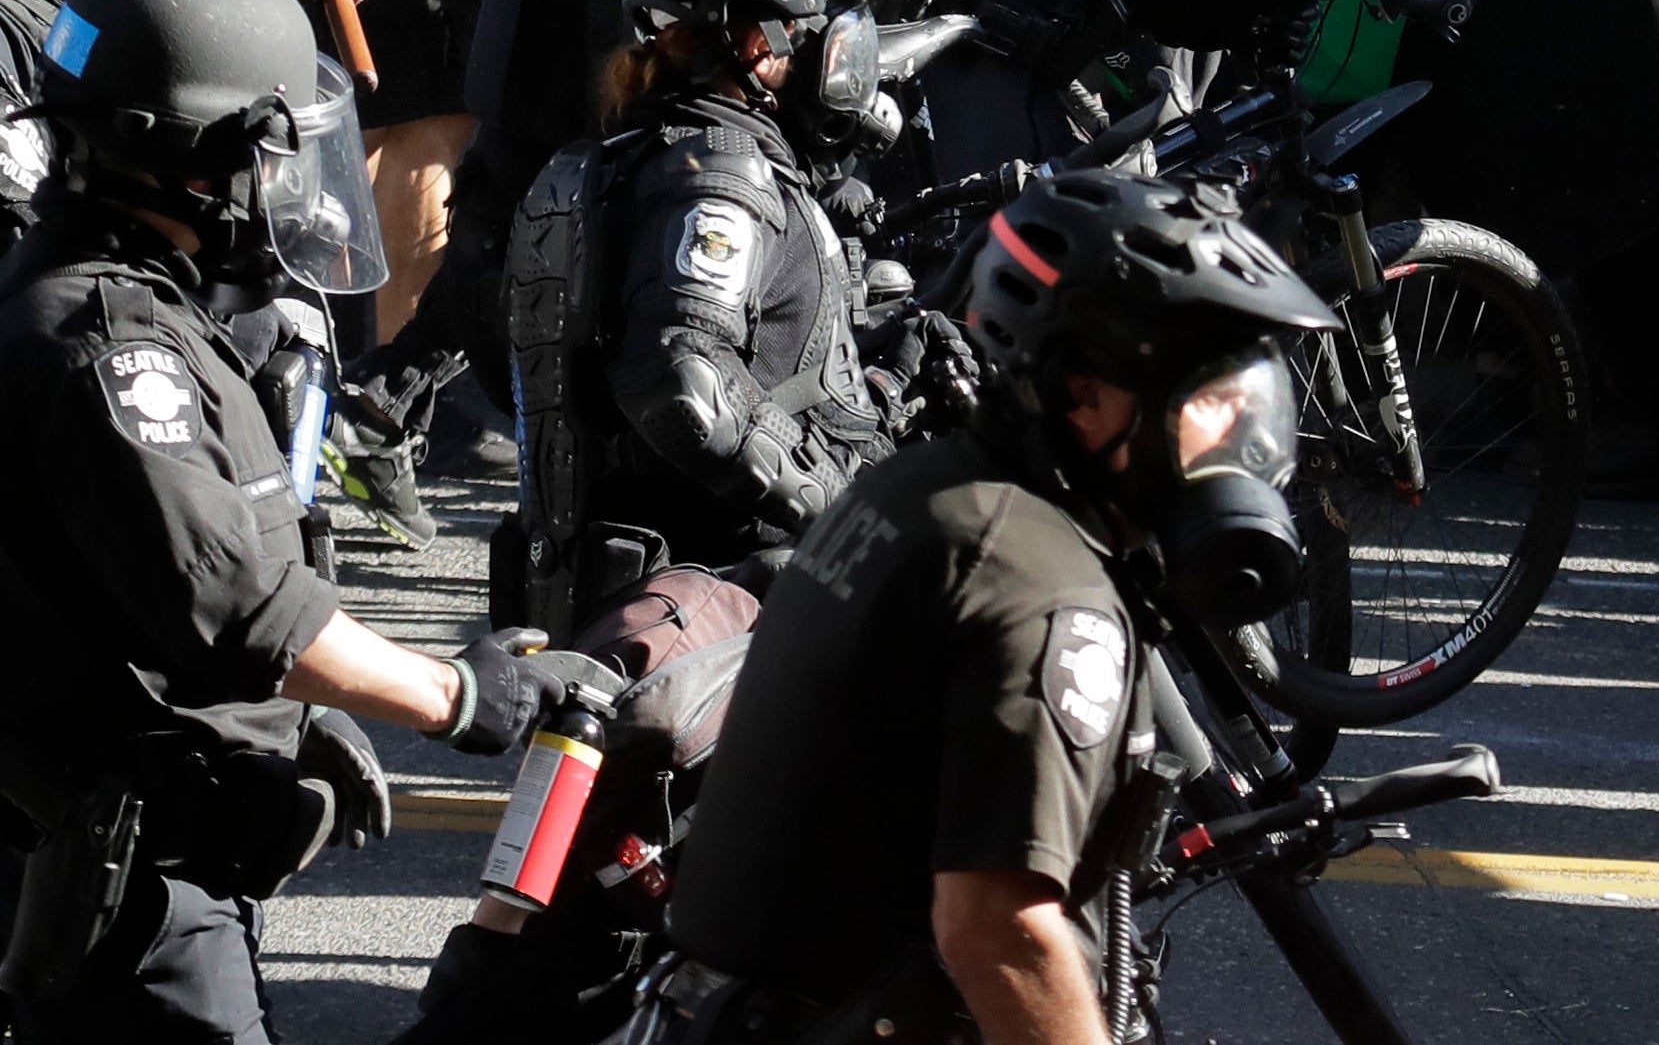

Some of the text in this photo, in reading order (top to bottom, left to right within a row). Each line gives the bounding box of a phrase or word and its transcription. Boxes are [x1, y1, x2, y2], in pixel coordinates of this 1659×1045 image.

[111, 350, 180, 377] SEATTLE
[1549, 333, 1578, 420] SERFAS
[138, 420, 192, 444] POLICE
[790, 489, 901, 602] LICE
